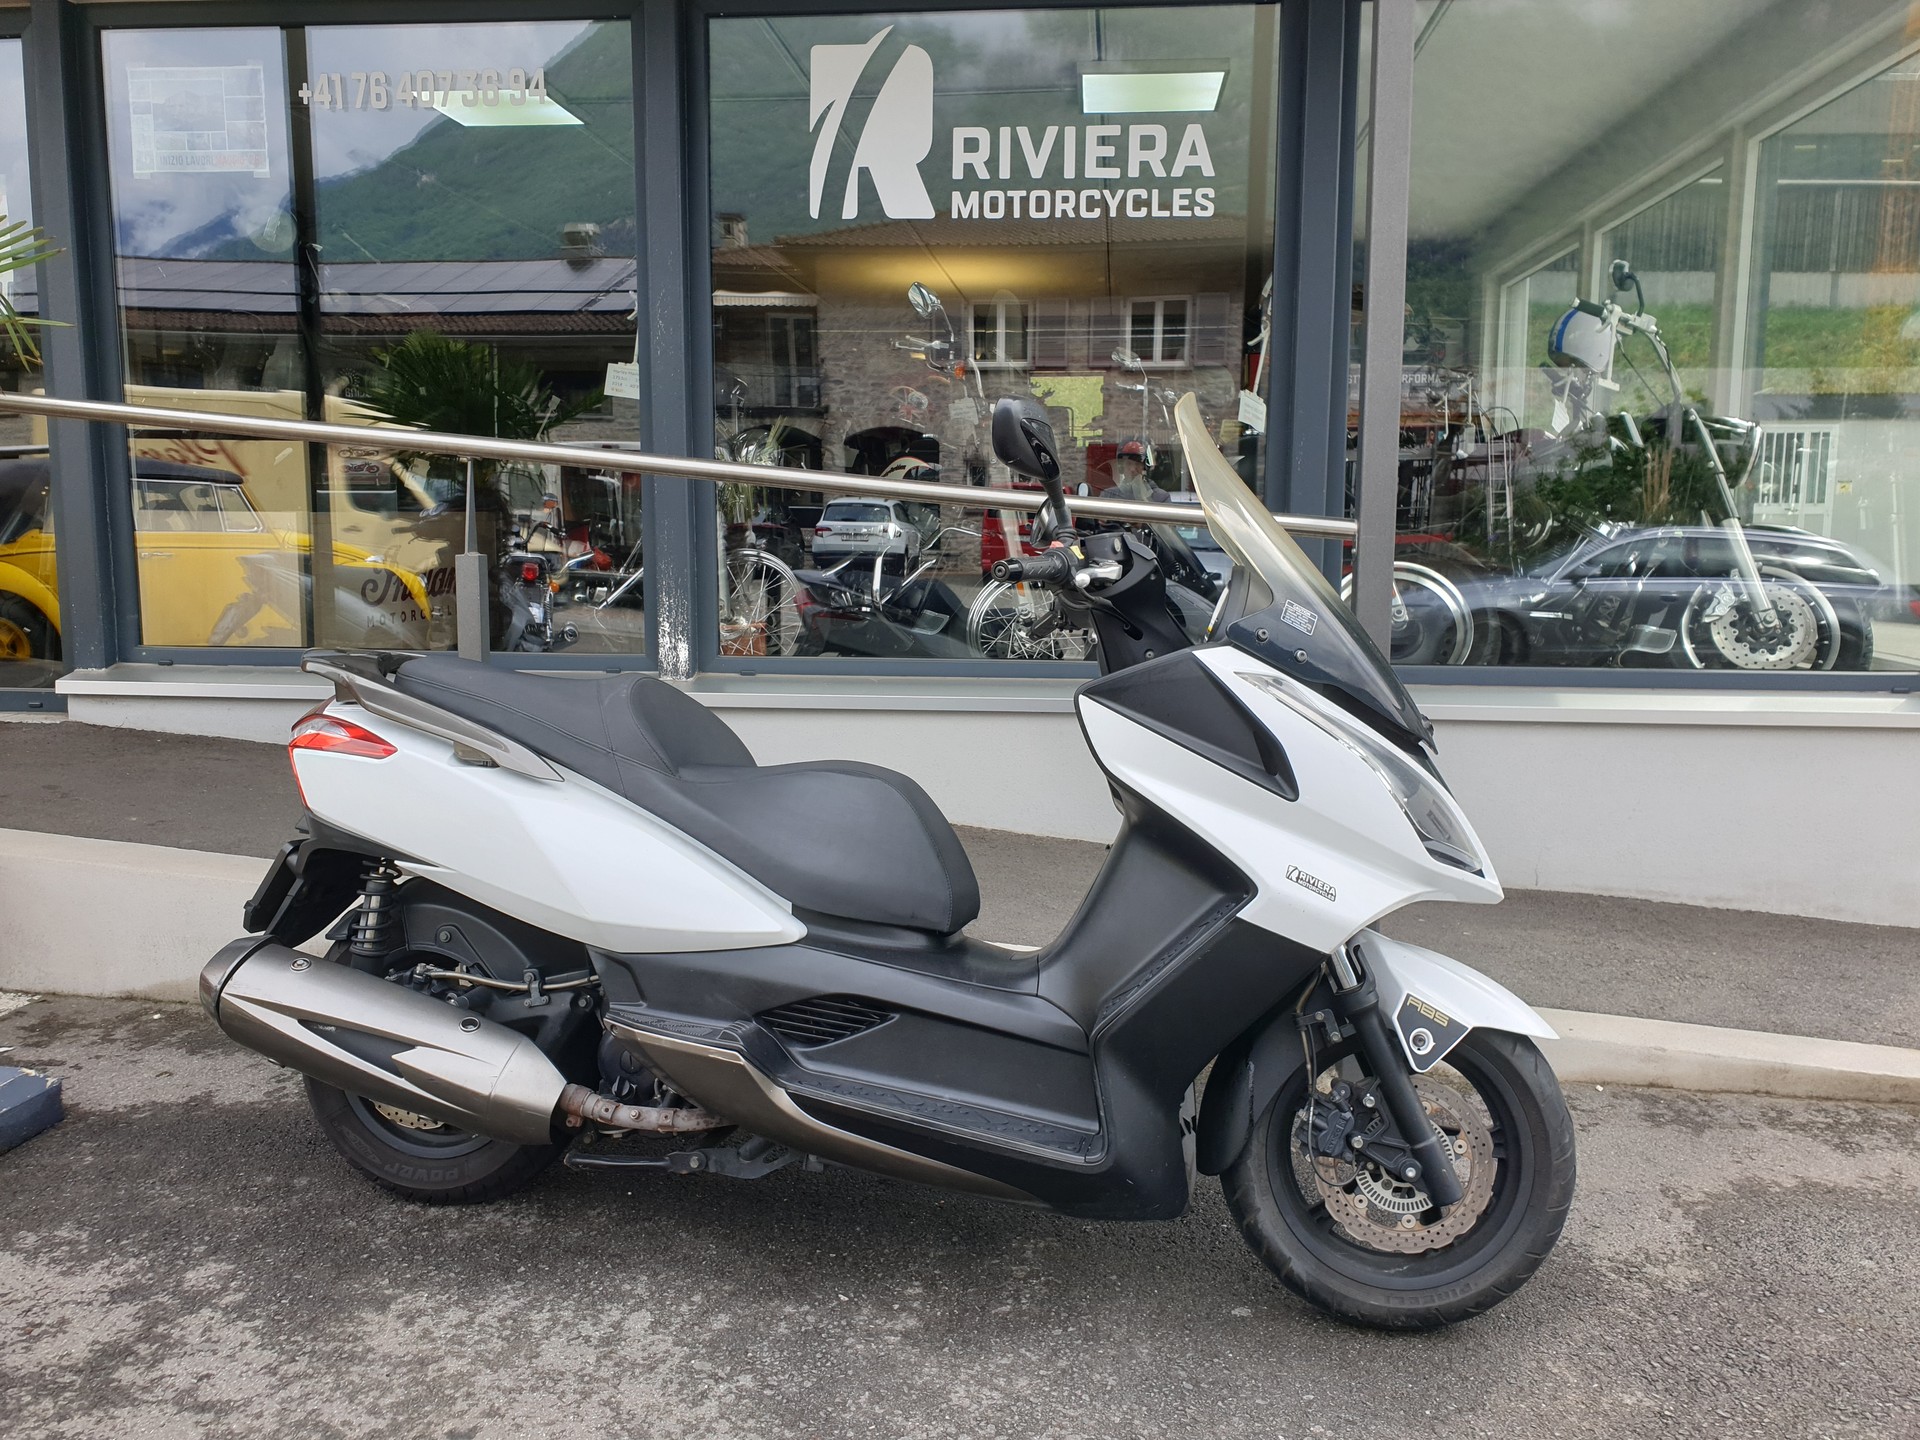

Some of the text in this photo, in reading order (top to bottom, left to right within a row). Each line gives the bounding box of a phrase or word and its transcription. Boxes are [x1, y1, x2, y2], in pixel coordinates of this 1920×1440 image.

[297, 73, 342, 110] +41
[352, 71, 388, 109] 76
[508, 67, 547, 105] 94
[951, 124, 1216, 180] RIVIERA
[951, 187, 1216, 219] MOTORCYCLES
[1298, 879, 1334, 901] MOTORCYCLES
[1299, 871, 1336, 897] RIVIERA
[1407, 996, 1449, 1027] ABS
